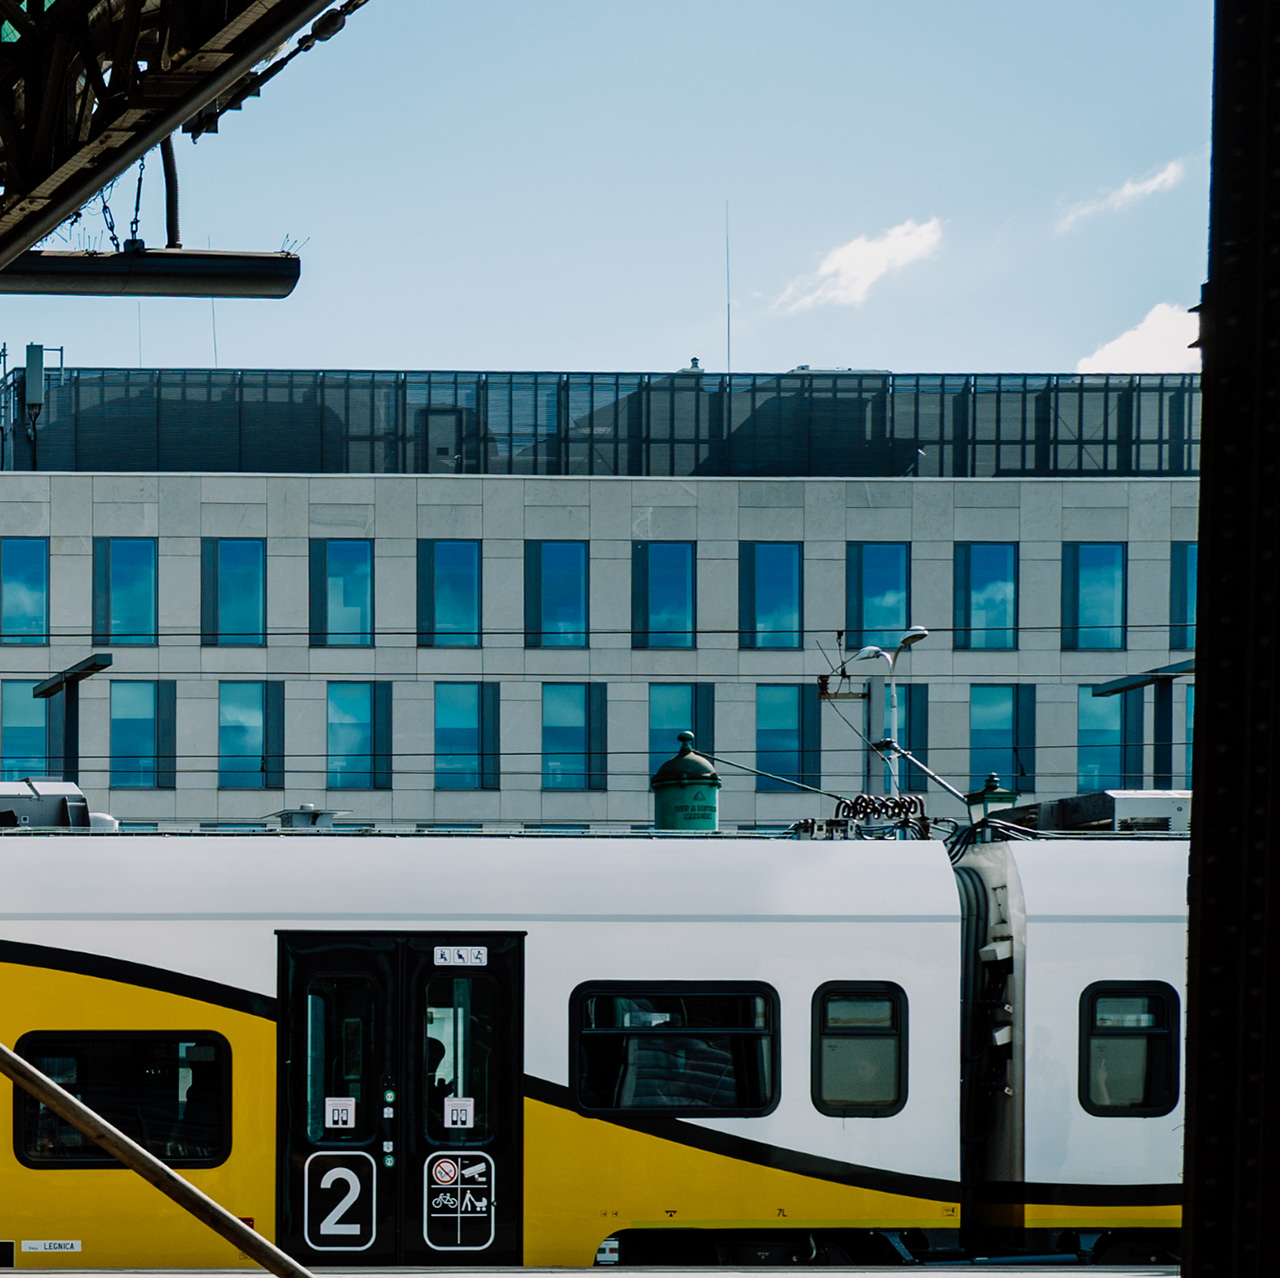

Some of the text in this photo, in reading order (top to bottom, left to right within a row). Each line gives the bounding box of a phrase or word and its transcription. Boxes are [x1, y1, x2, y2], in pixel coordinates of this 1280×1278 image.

[320, 1167, 361, 1235] 2
[777, 1208, 788, 1217] 7L
[43, 1242, 75, 1251] LEGNICA
